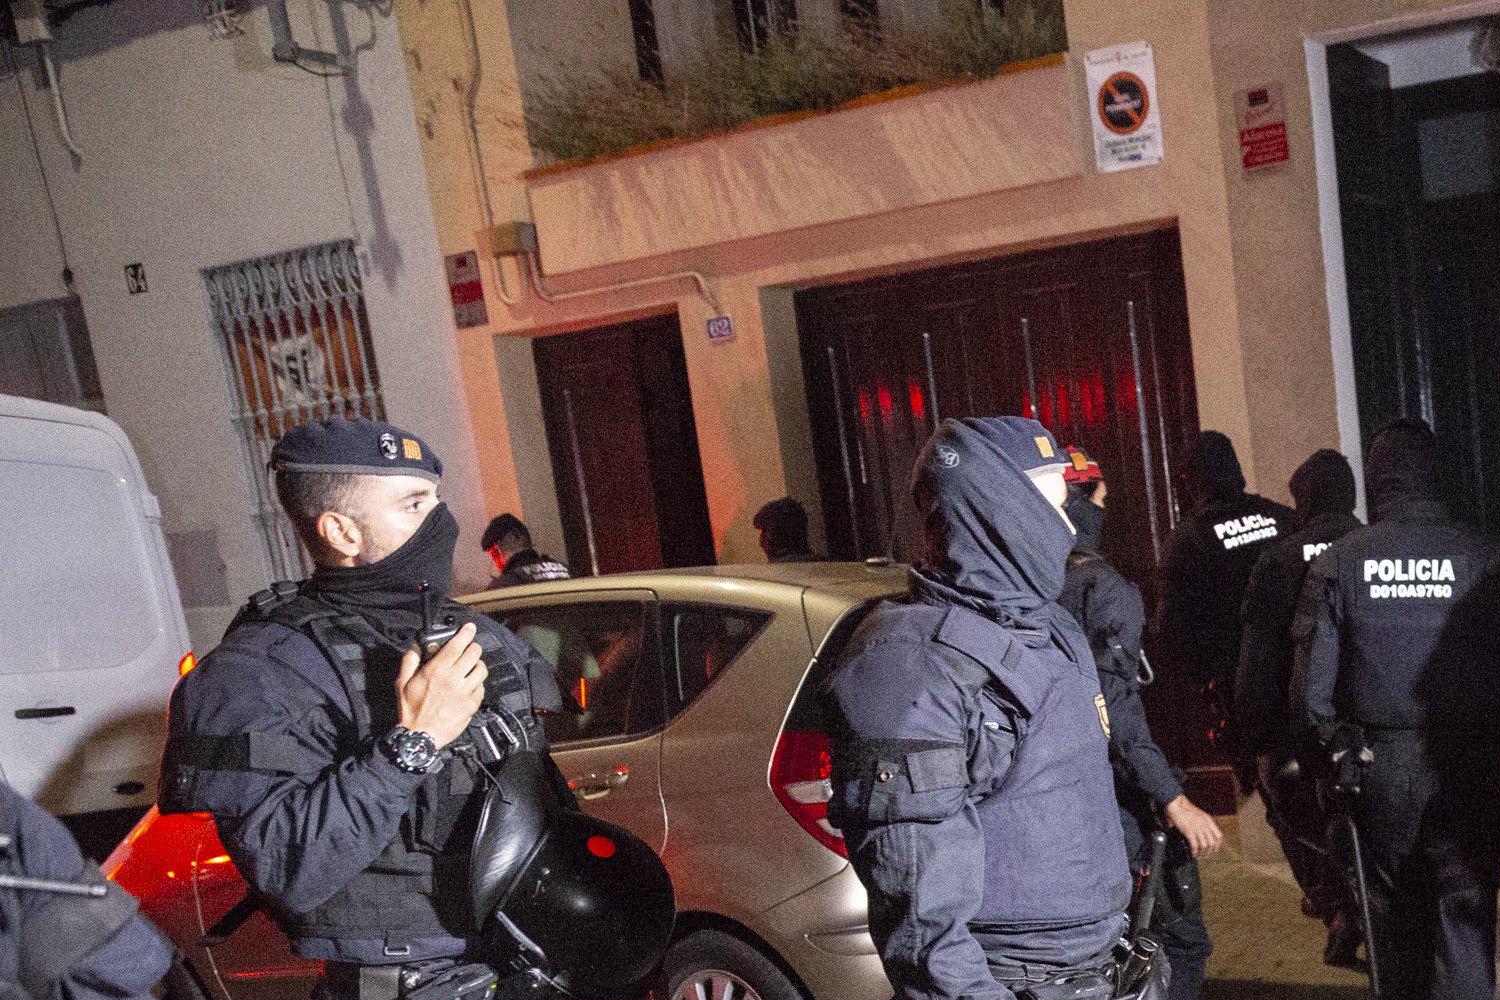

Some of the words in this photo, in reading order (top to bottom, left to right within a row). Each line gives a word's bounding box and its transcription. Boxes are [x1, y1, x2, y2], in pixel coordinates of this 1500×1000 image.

[127, 265, 147, 292] 64
[709, 318, 731, 337] 62
[1363, 558, 1456, 582] POLICIA
[1369, 583, 1453, 599] D010A9760
